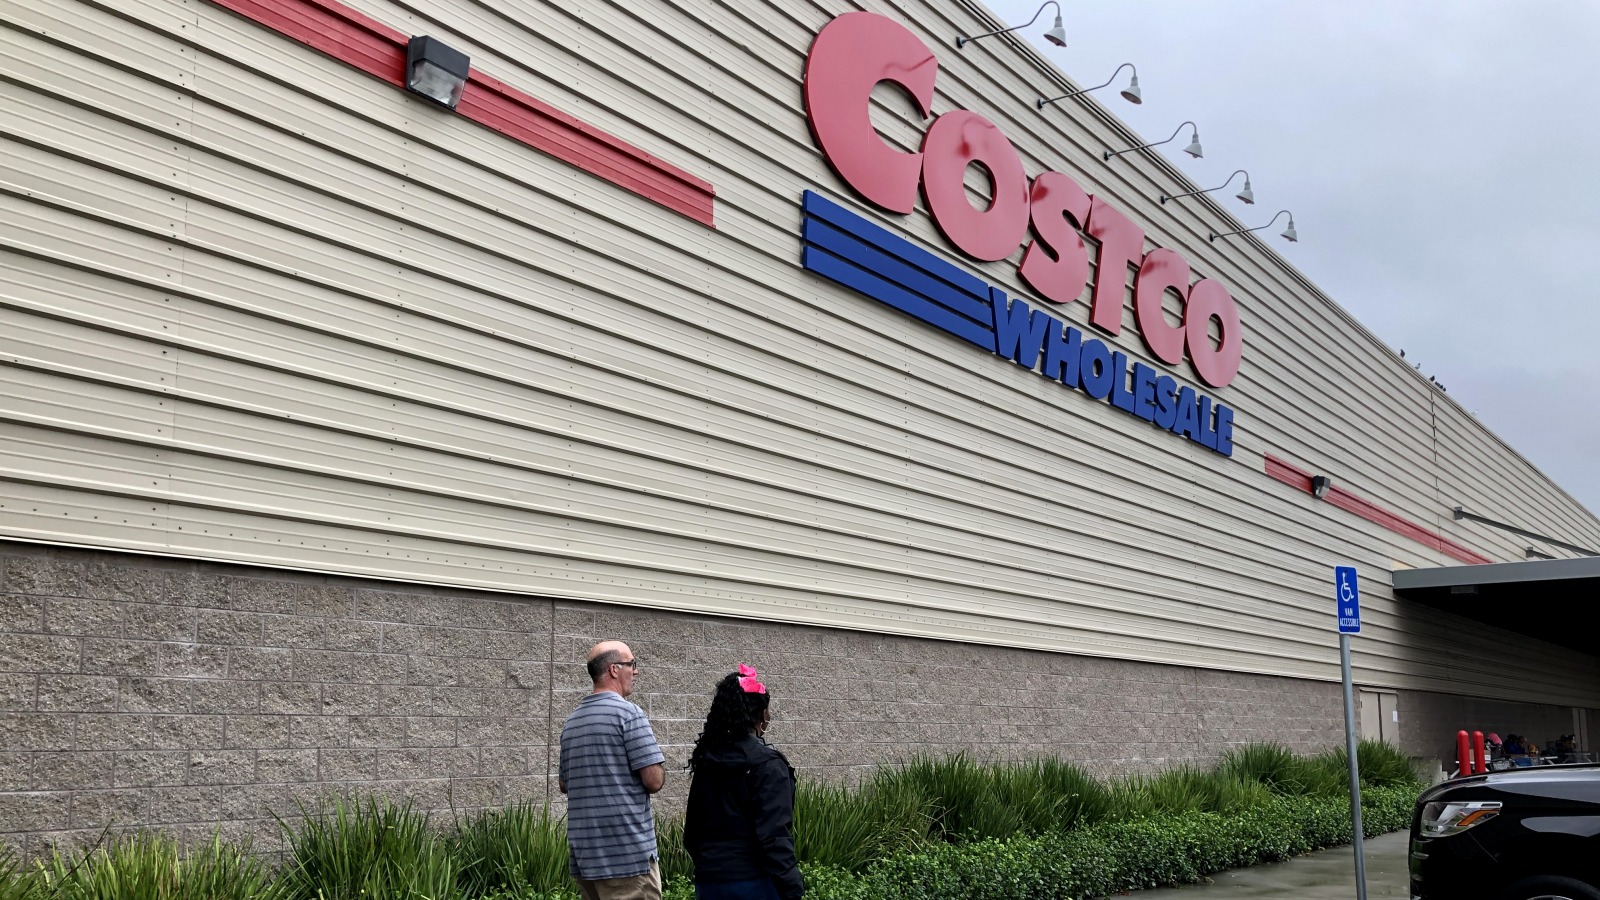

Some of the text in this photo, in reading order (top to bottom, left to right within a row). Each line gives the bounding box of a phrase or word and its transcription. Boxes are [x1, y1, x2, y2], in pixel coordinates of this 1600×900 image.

[804, 11, 1243, 388] COSTCO
[988, 286, 1234, 457] WHOLESALE
[1340, 617, 1359, 627] ACCESSIBLE
[1344, 607, 1353, 617] VAN
